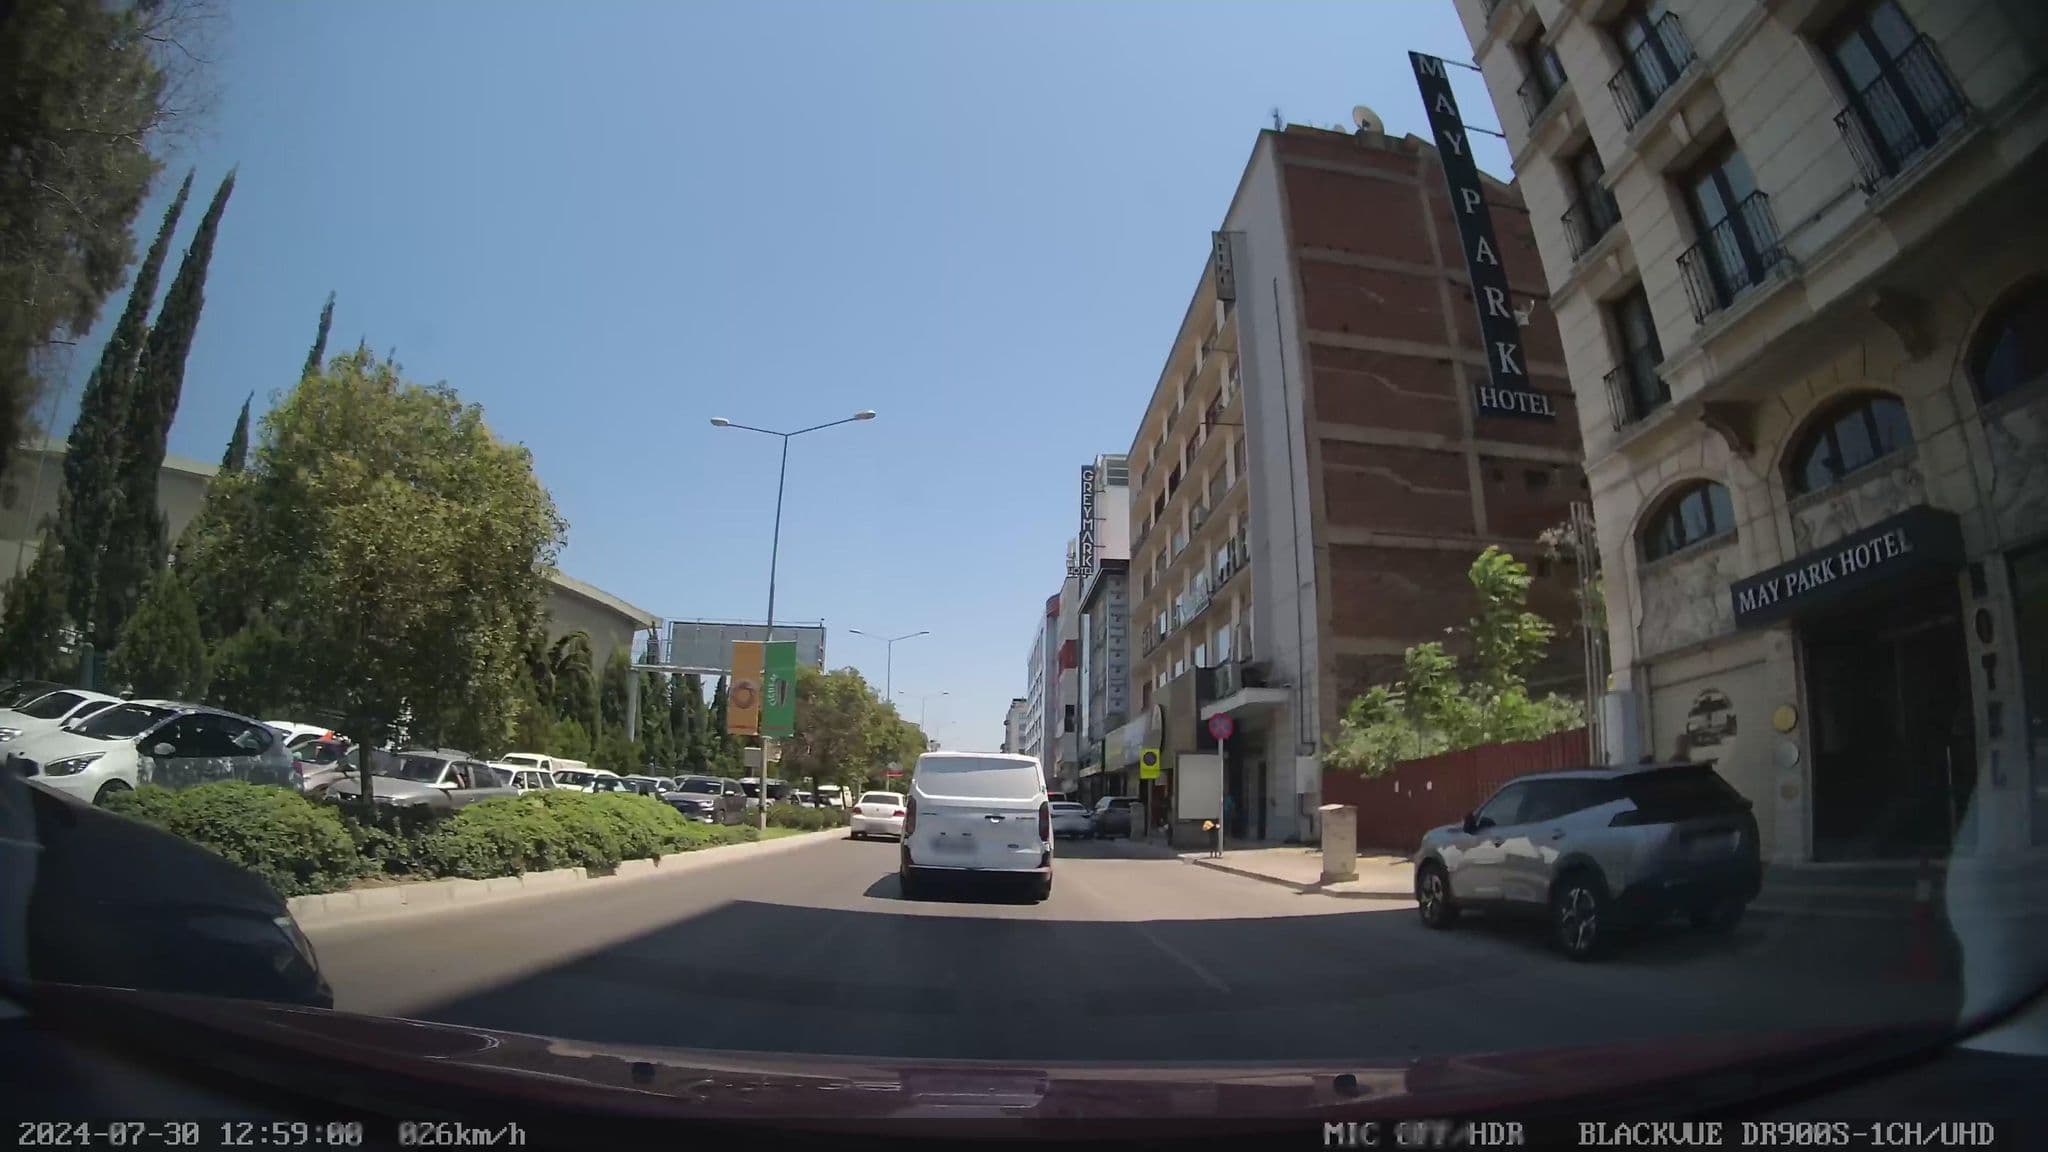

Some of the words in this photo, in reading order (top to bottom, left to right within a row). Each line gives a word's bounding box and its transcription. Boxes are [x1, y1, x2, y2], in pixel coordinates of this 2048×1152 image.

[1418, 54, 1465, 156] MAY
[1460, 187, 1522, 376] PARK
[1479, 385, 1556, 417] HOTEL
[1082, 470, 1094, 567] GREYMARK
[1738, 578, 1780, 615] MAY
[1785, 557, 1837, 598] PARK
[1839, 528, 1914, 577] HOTEL
